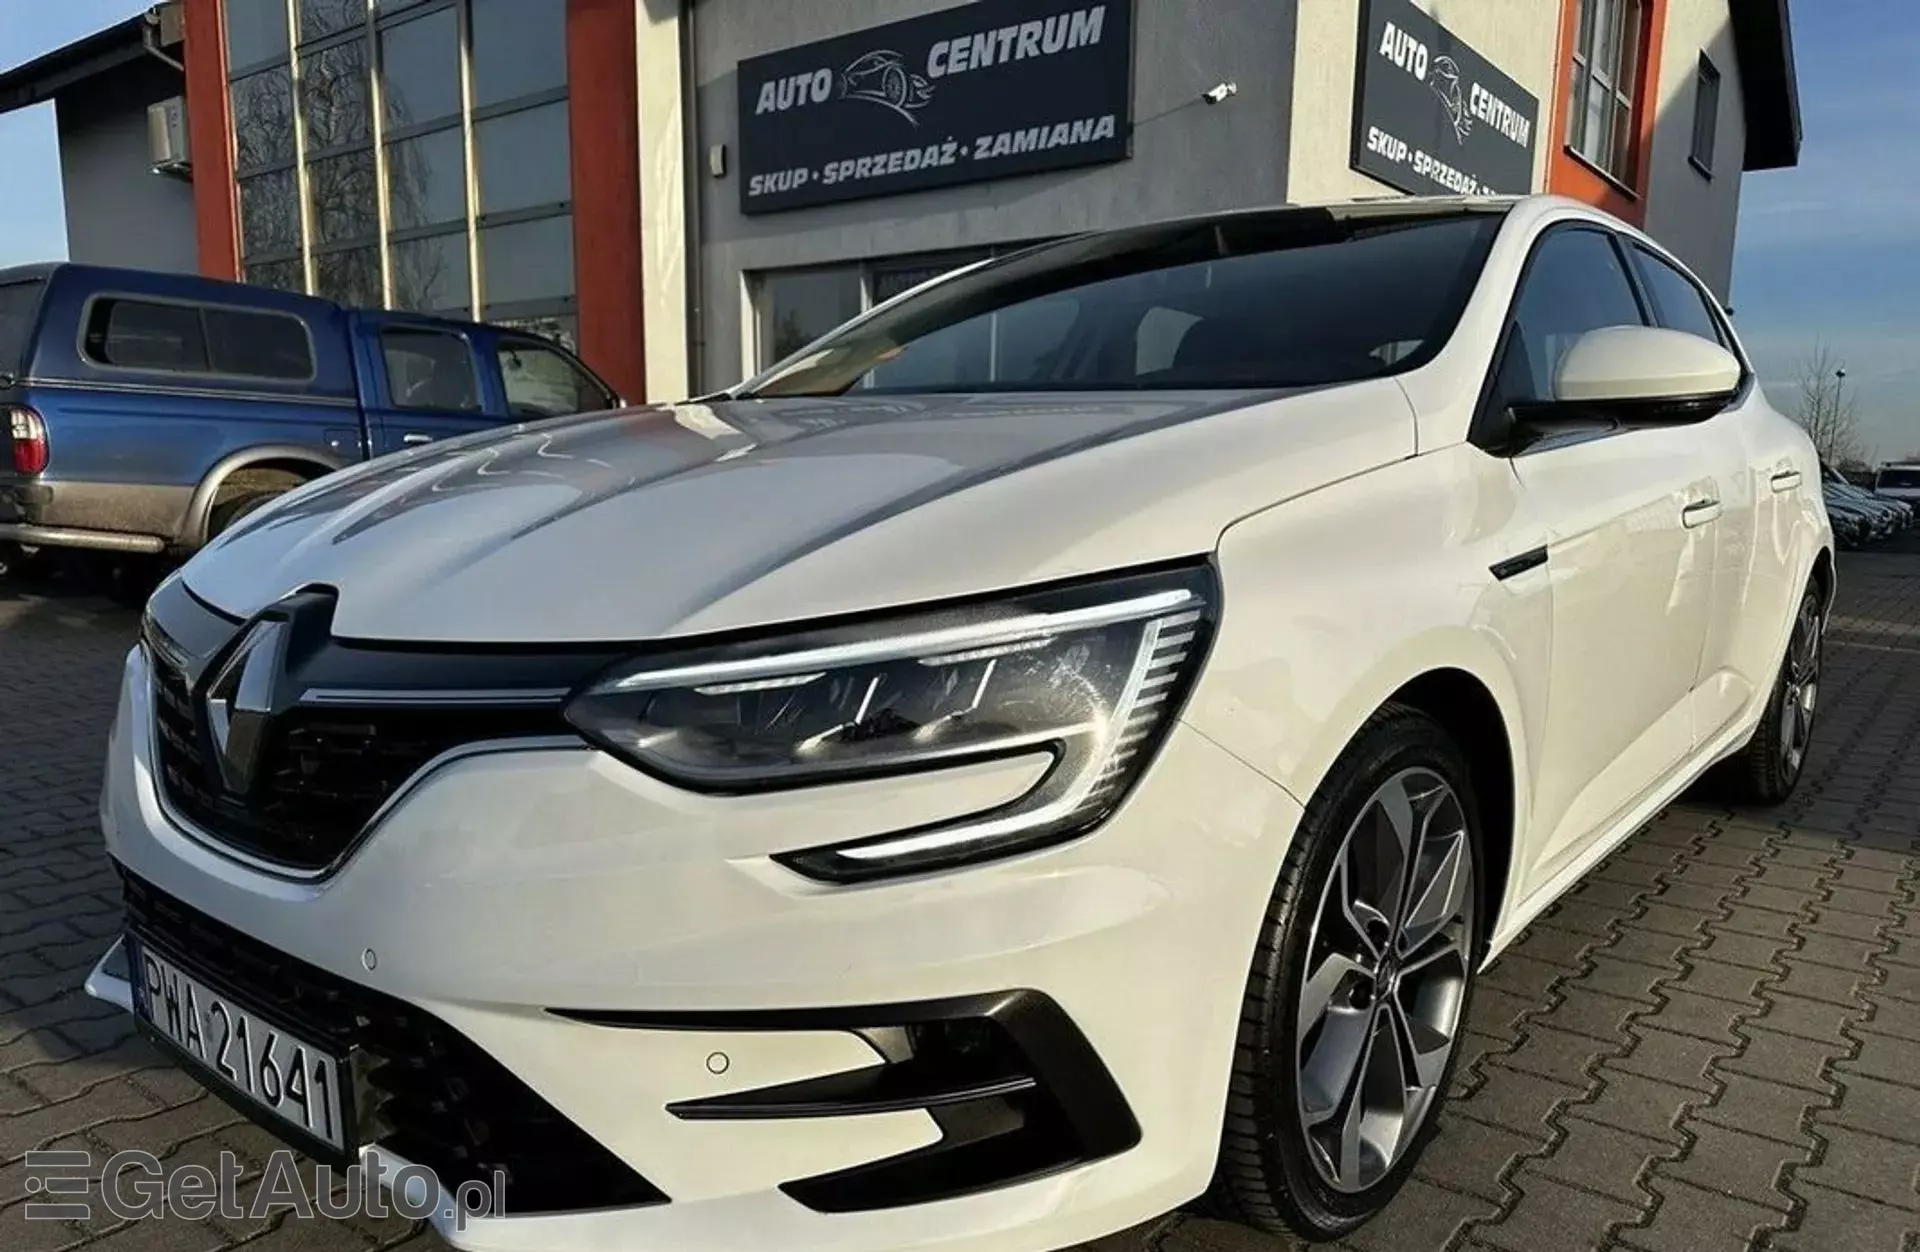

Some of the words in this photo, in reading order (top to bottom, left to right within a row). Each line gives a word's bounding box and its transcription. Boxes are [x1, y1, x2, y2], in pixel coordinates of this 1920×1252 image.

[755, 68, 833, 115] AUTO
[927, 6, 1106, 79] CENTRUM
[1379, 21, 1428, 81] AUTO
[1469, 82, 1531, 148] CENTRUM
[748, 169, 808, 197] SKUP
[822, 136, 957, 185] SPRZEDAŻ
[974, 114, 1116, 160] ZAMIANA
[1366, 126, 1408, 162] SKUP
[1413, 149, 1478, 196] SPRZEDAŻ
[143, 952, 206, 1060] PWA
[210, 1000, 334, 1141] 21641
